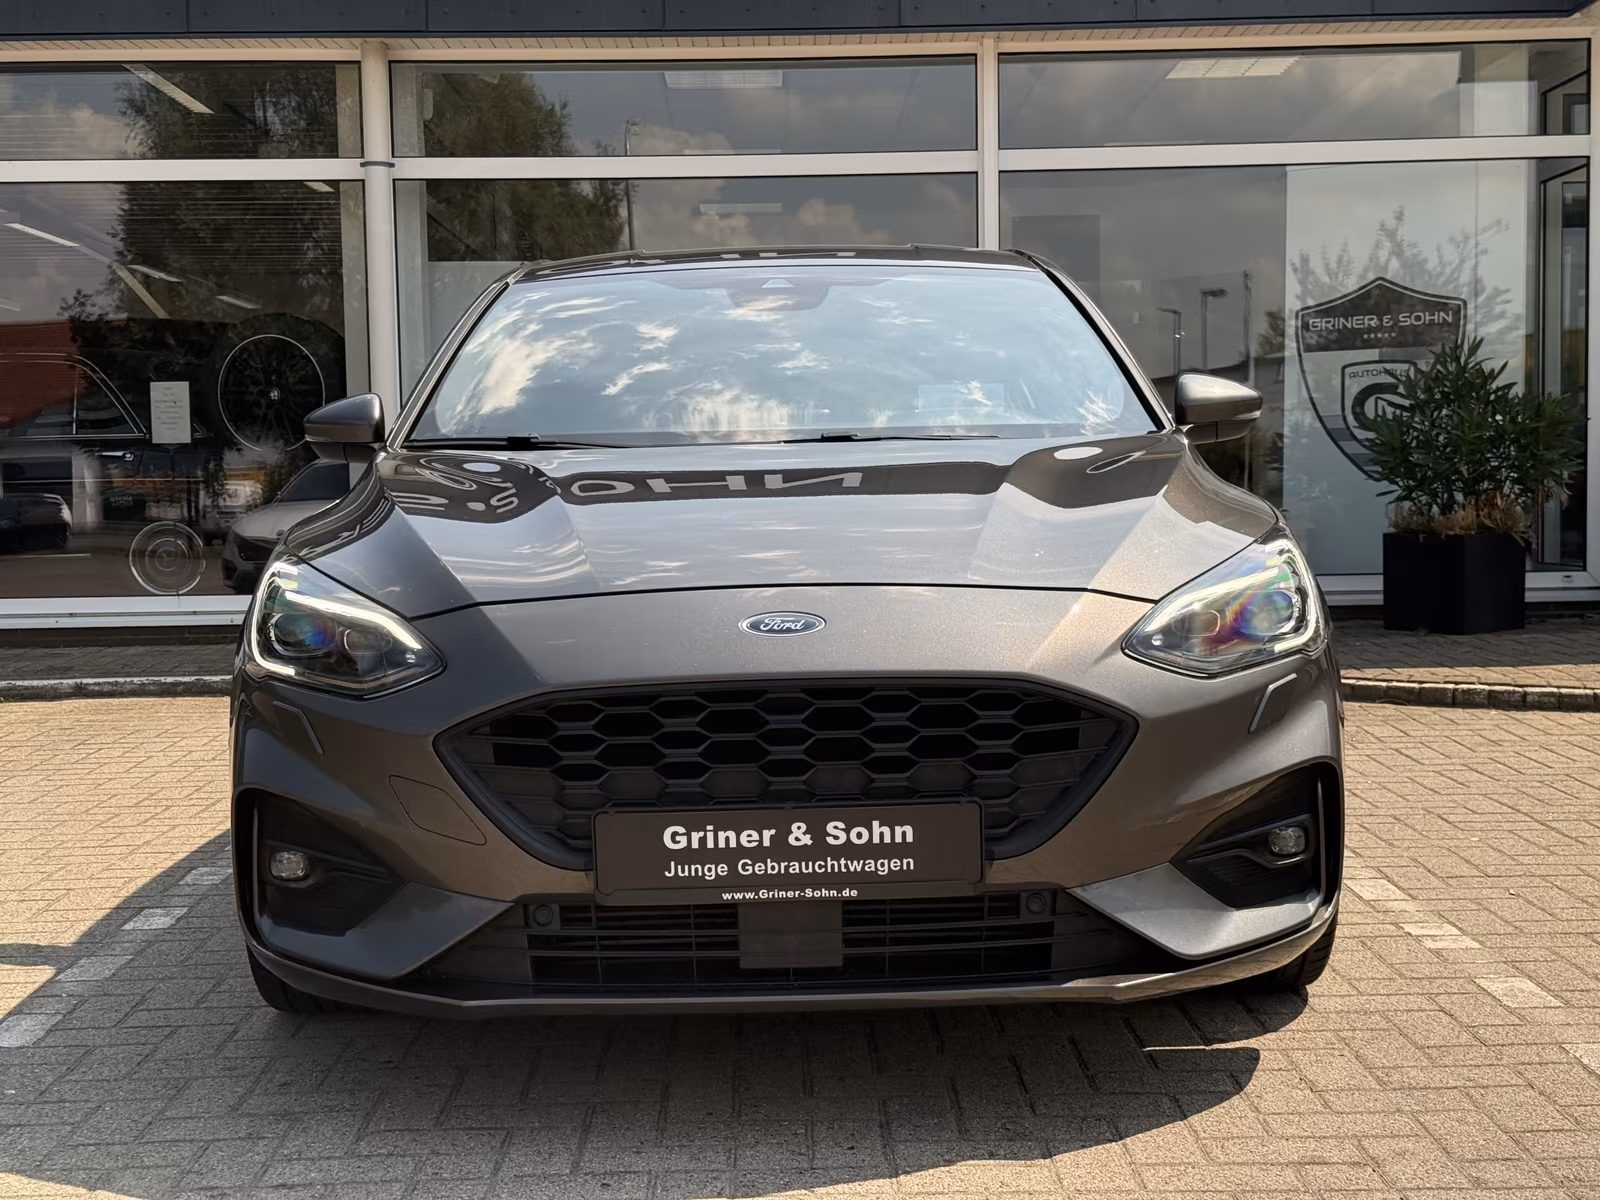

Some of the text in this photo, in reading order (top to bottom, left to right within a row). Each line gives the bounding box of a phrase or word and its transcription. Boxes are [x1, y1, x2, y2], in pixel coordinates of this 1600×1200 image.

[1309, 311, 1453, 331] GRINER & SOHN
[760, 617, 806, 631] Ford
[663, 820, 914, 850] Griner & Sohn
[664, 857, 915, 880] Junge Gebrauchtwagen
[722, 888, 858, 900] www.Griner-Sohn.de
